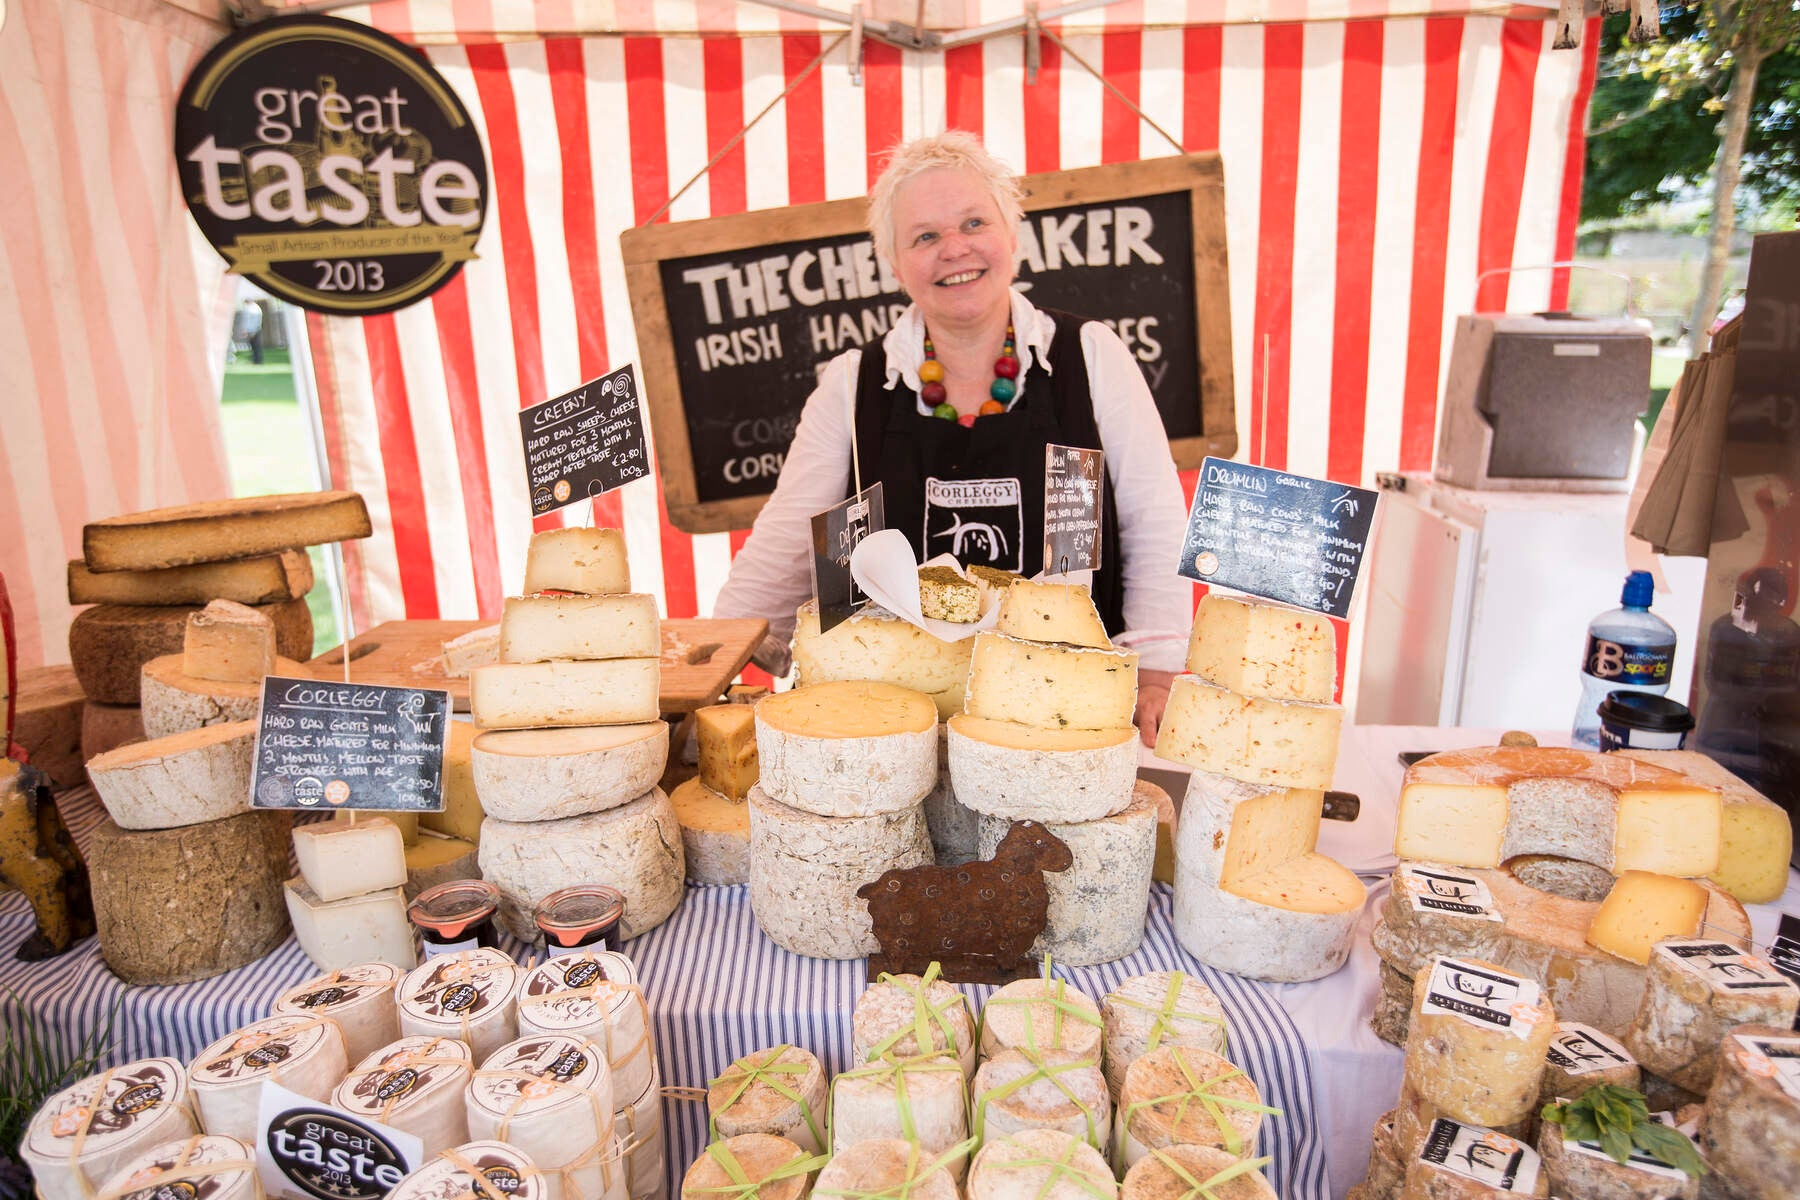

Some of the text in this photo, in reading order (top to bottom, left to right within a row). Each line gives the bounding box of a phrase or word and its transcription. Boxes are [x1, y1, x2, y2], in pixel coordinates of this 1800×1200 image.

[253, 85, 412, 145] great
[186, 133, 482, 228] taste
[239, 240, 279, 256] Small
[282, 238, 330, 252] Artisan
[333, 234, 391, 250] Producer
[395, 233, 409, 247] of
[411, 231, 433, 246] the
[312, 259, 385, 292] 2013
[695, 323, 783, 373] IRISH
[532, 389, 588, 427] CREENY
[527, 434, 551, 454] HARD
[552, 425, 574, 443] RAW
[529, 443, 568, 466] MATURED
[570, 434, 588, 450] FOR
[590, 428, 600, 442] 3
[603, 433, 623, 448] WITH
[625, 429, 632, 441] A
[533, 469, 560, 489] SHARP
[562, 458, 587, 476] AFTER
[619, 464, 645, 480] 100g
[1207, 466, 1268, 492] DRUMLIN
[534, 493, 553, 507] taste
[932, 485, 1013, 499] CORLEGGY
[1202, 491, 1232, 509] HARD
[1238, 501, 1265, 515] RAW
[1312, 513, 1341, 530] MILK
[1194, 519, 1206, 534] 3
[1325, 549, 1356, 566] WITH
[1623, 661, 1669, 675] sports
[284, 683, 387, 709] CORLEGGY
[263, 714, 296, 731] HARD
[300, 716, 324, 731] RAW
[373, 722, 397, 735] MILK
[317, 735, 367, 749] MATURED
[371, 738, 390, 751] FOR
[263, 750, 276, 765] 2
[338, 752, 385, 766] MELLOW
[387, 753, 426, 766] TASTE
[274, 766, 337, 777] STRONGER
[343, 766, 369, 777] WITH
[295, 786, 324, 797] taste
[568, 963, 597, 986] taste
[444, 985, 474, 1010] taste
[556, 1050, 581, 1076] taste
[116, 1087, 161, 1111] taste
[304, 1121, 376, 1154] great
[271, 1128, 404, 1188] taste
[321, 1167, 352, 1184] 2013
